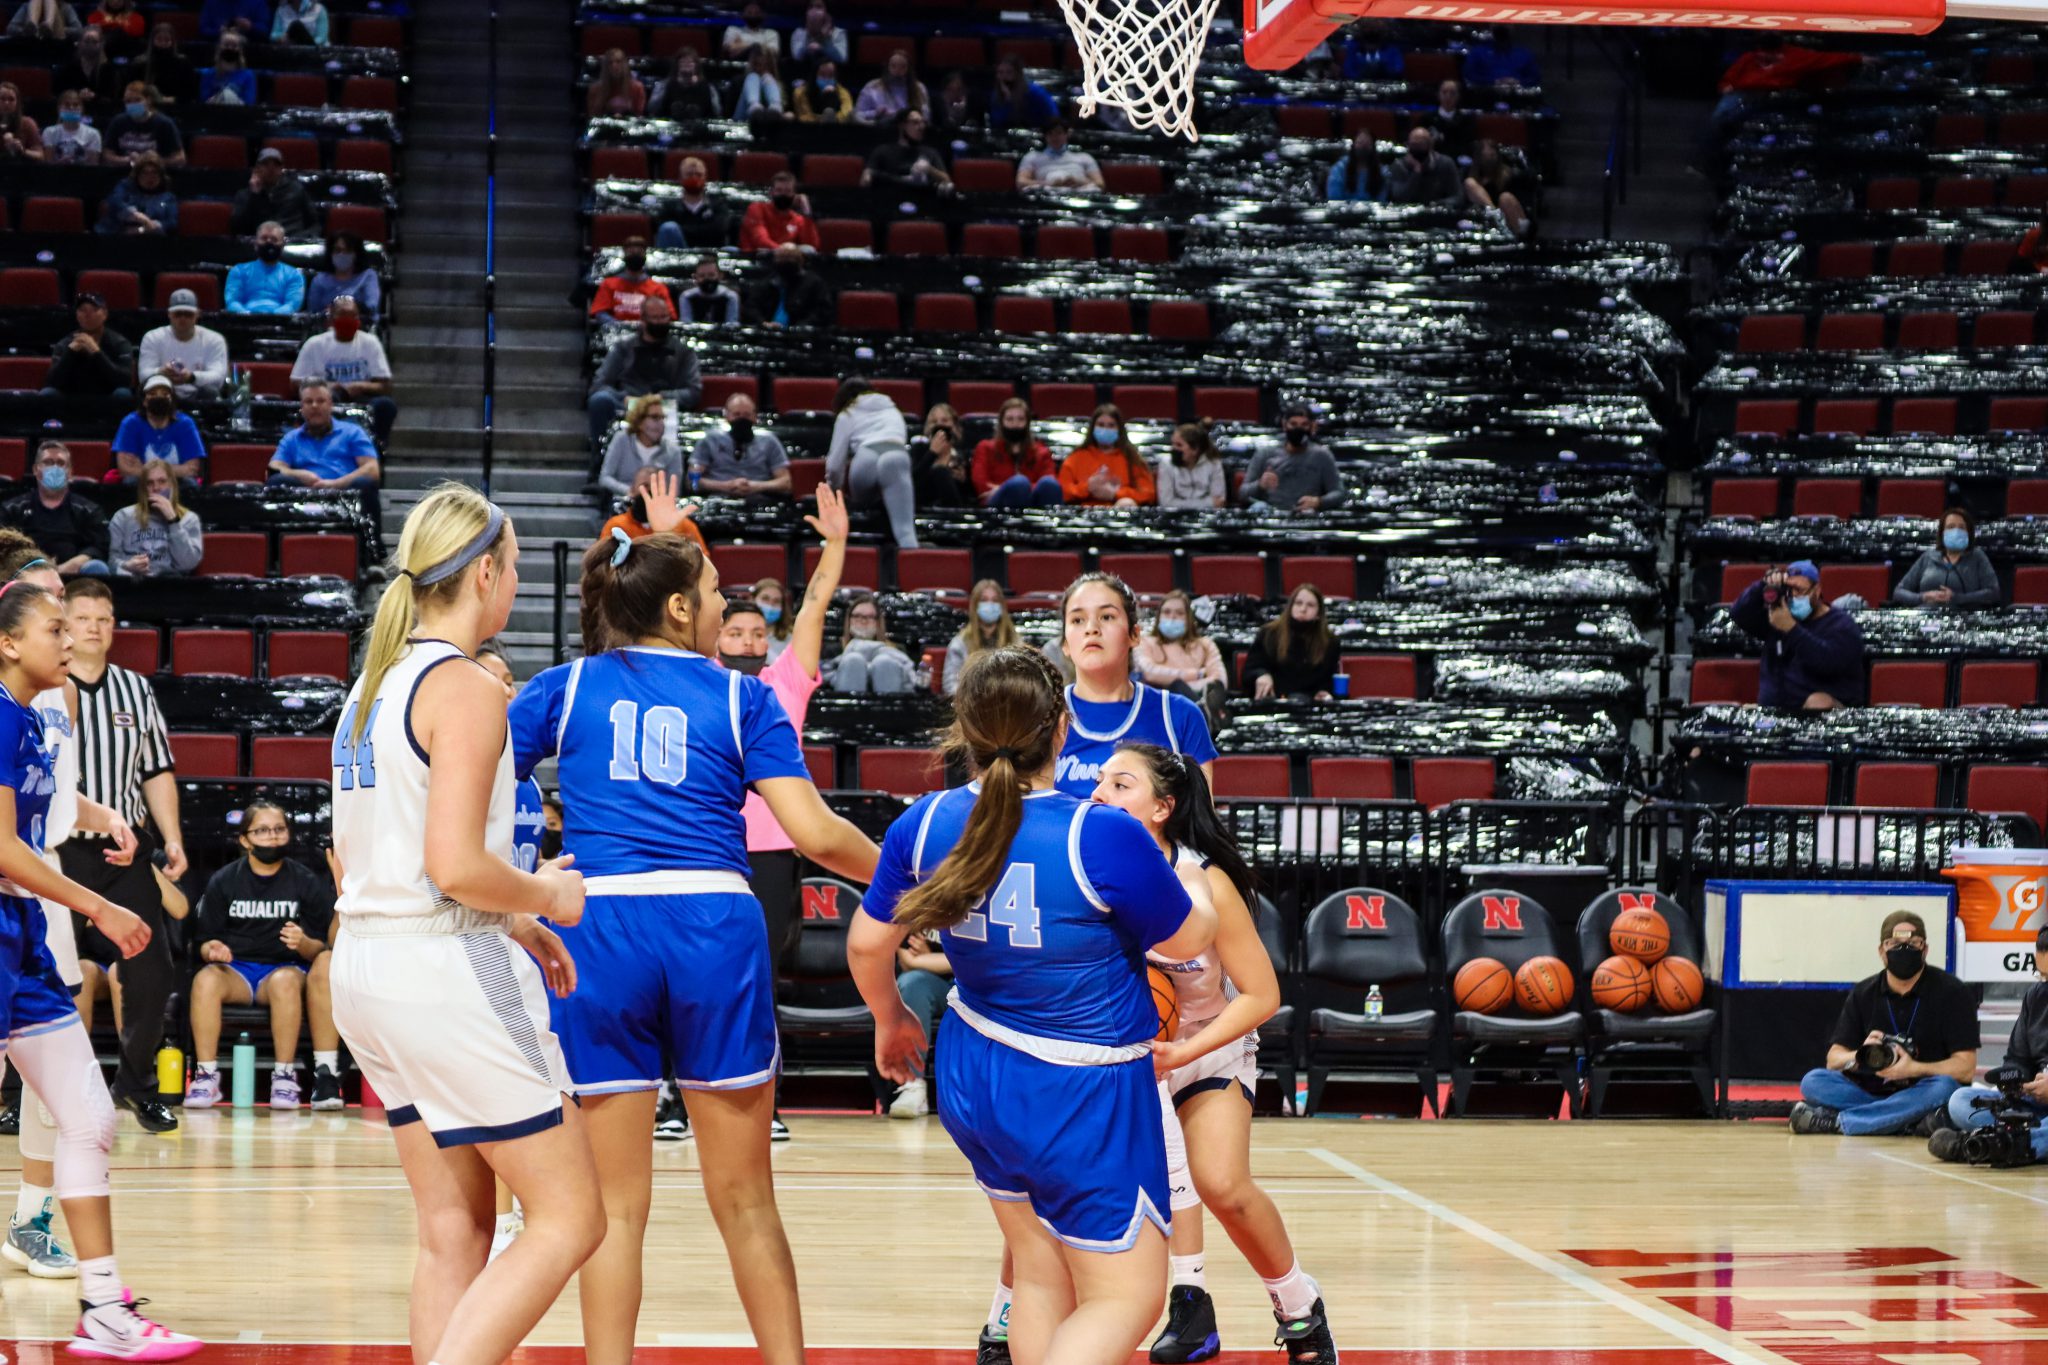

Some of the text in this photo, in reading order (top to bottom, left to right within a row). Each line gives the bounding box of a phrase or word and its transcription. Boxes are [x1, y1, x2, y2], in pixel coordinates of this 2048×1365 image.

[609, 699, 688, 787] 10
[801, 885, 841, 920] N
[1346, 895, 1388, 930] N
[2014, 880, 2038, 911] G
[1482, 896, 1524, 931] N
